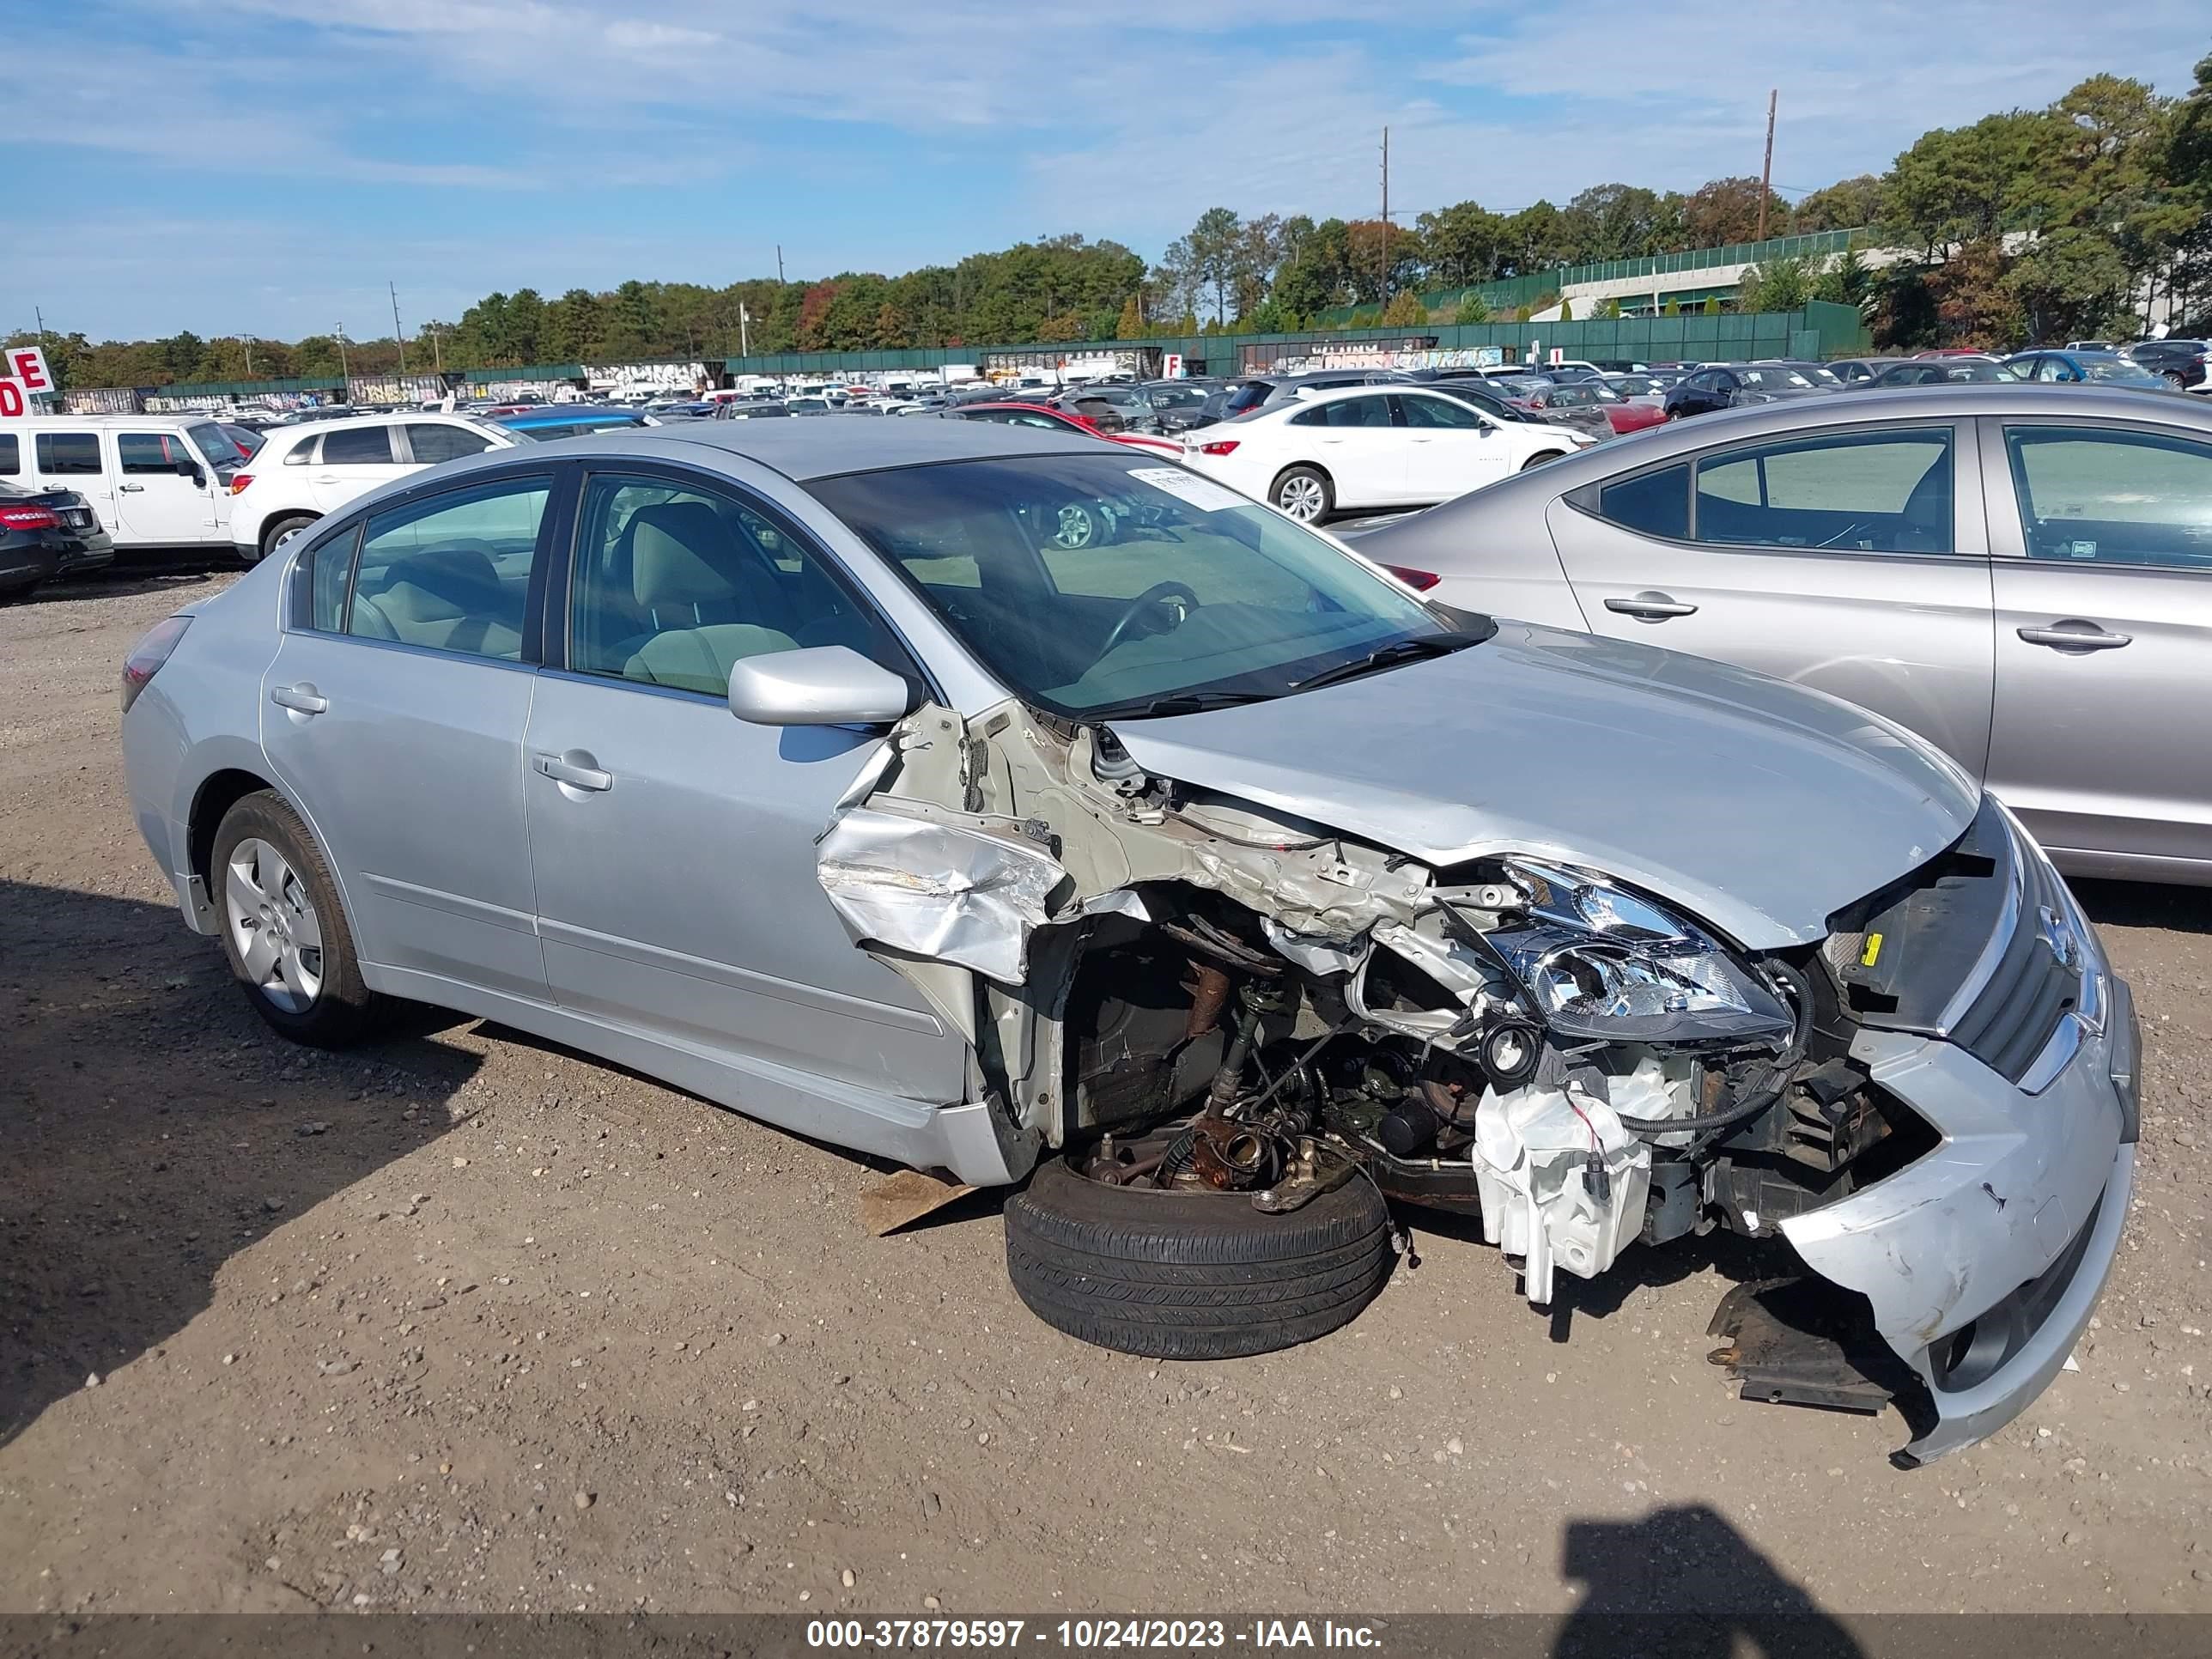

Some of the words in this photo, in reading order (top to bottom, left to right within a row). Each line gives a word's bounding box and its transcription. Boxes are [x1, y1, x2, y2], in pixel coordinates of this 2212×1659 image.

[14, 353, 46, 388] E
[1169, 356, 1178, 378] F
[0, 381, 23, 417] D
